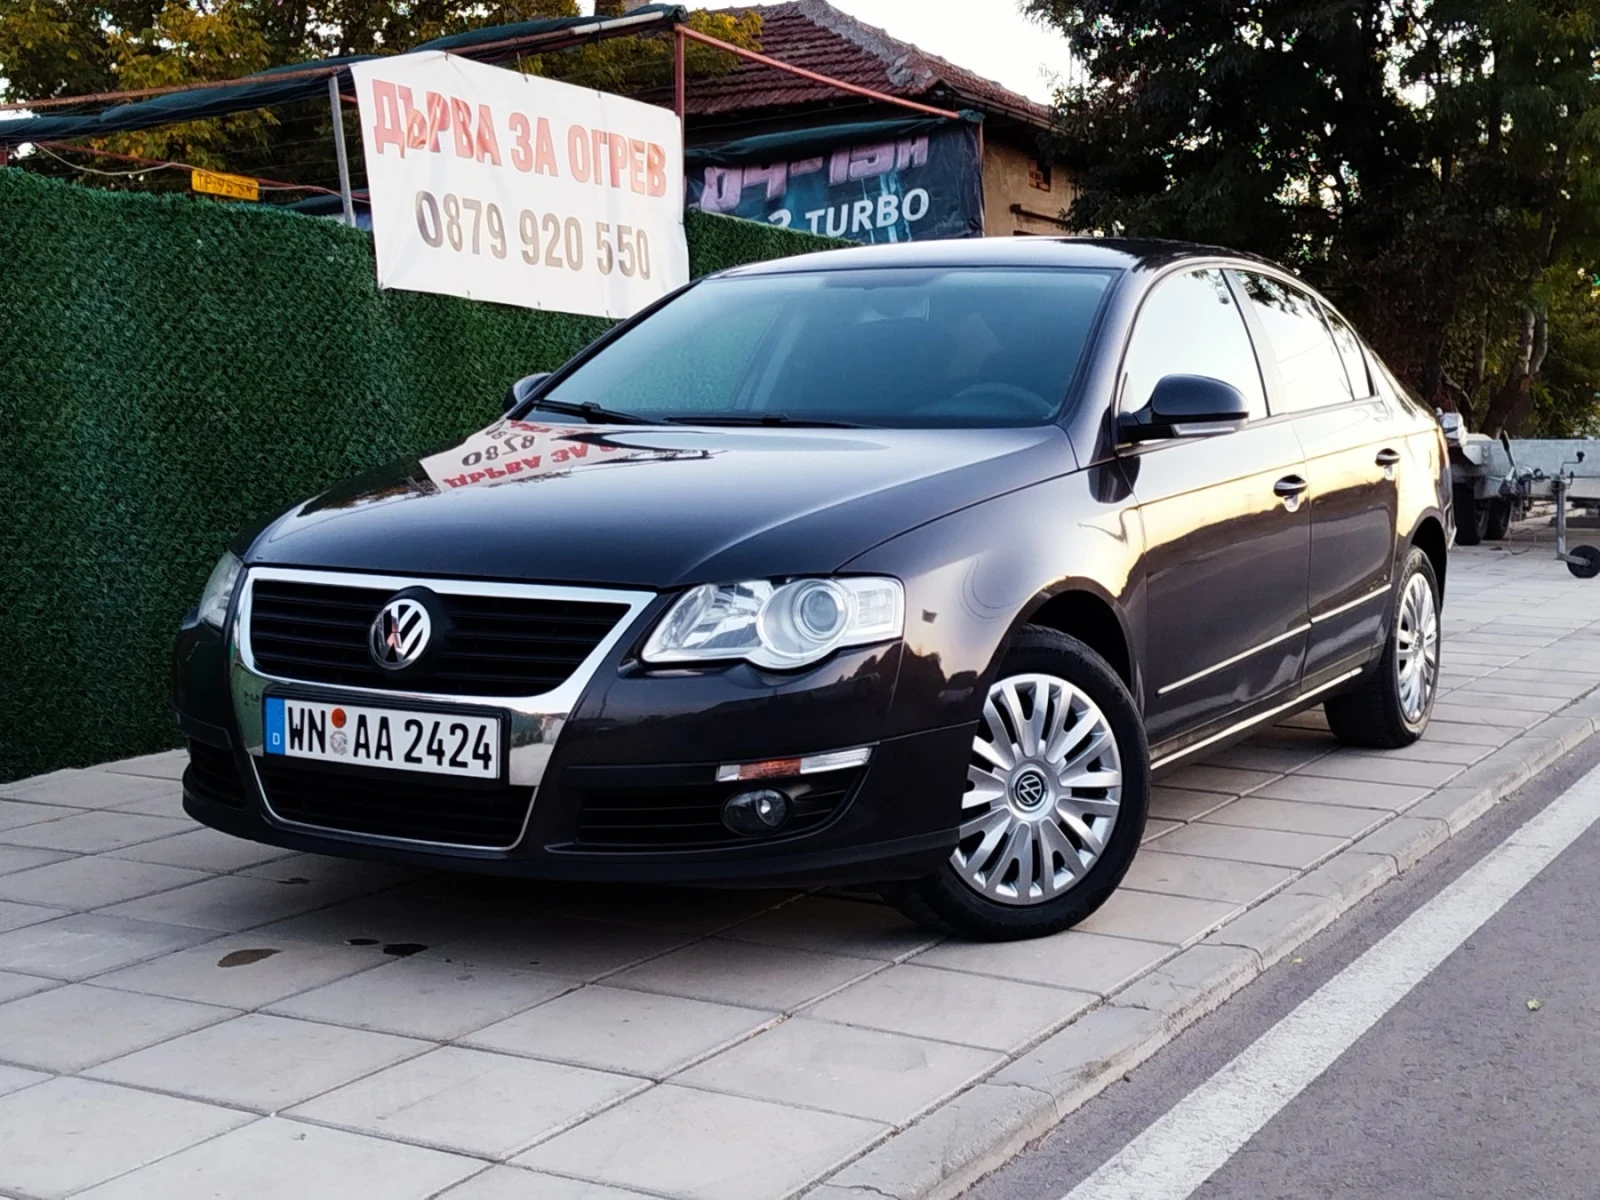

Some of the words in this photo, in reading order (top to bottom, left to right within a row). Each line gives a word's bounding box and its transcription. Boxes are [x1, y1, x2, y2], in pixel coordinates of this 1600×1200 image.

[371, 78, 502, 167] ДЪРВА
[508, 112, 559, 178] ЗА
[567, 124, 667, 198] ОГРЕВ
[415, 190, 507, 261] 0879
[519, 209, 584, 272] 920
[595, 221, 651, 281] 550
[805, 188, 930, 238] TURBO
[272, 732, 281, 745] D
[287, 706, 326, 754] WN
[352, 714, 394, 762] AA
[403, 719, 493, 771] 2424
